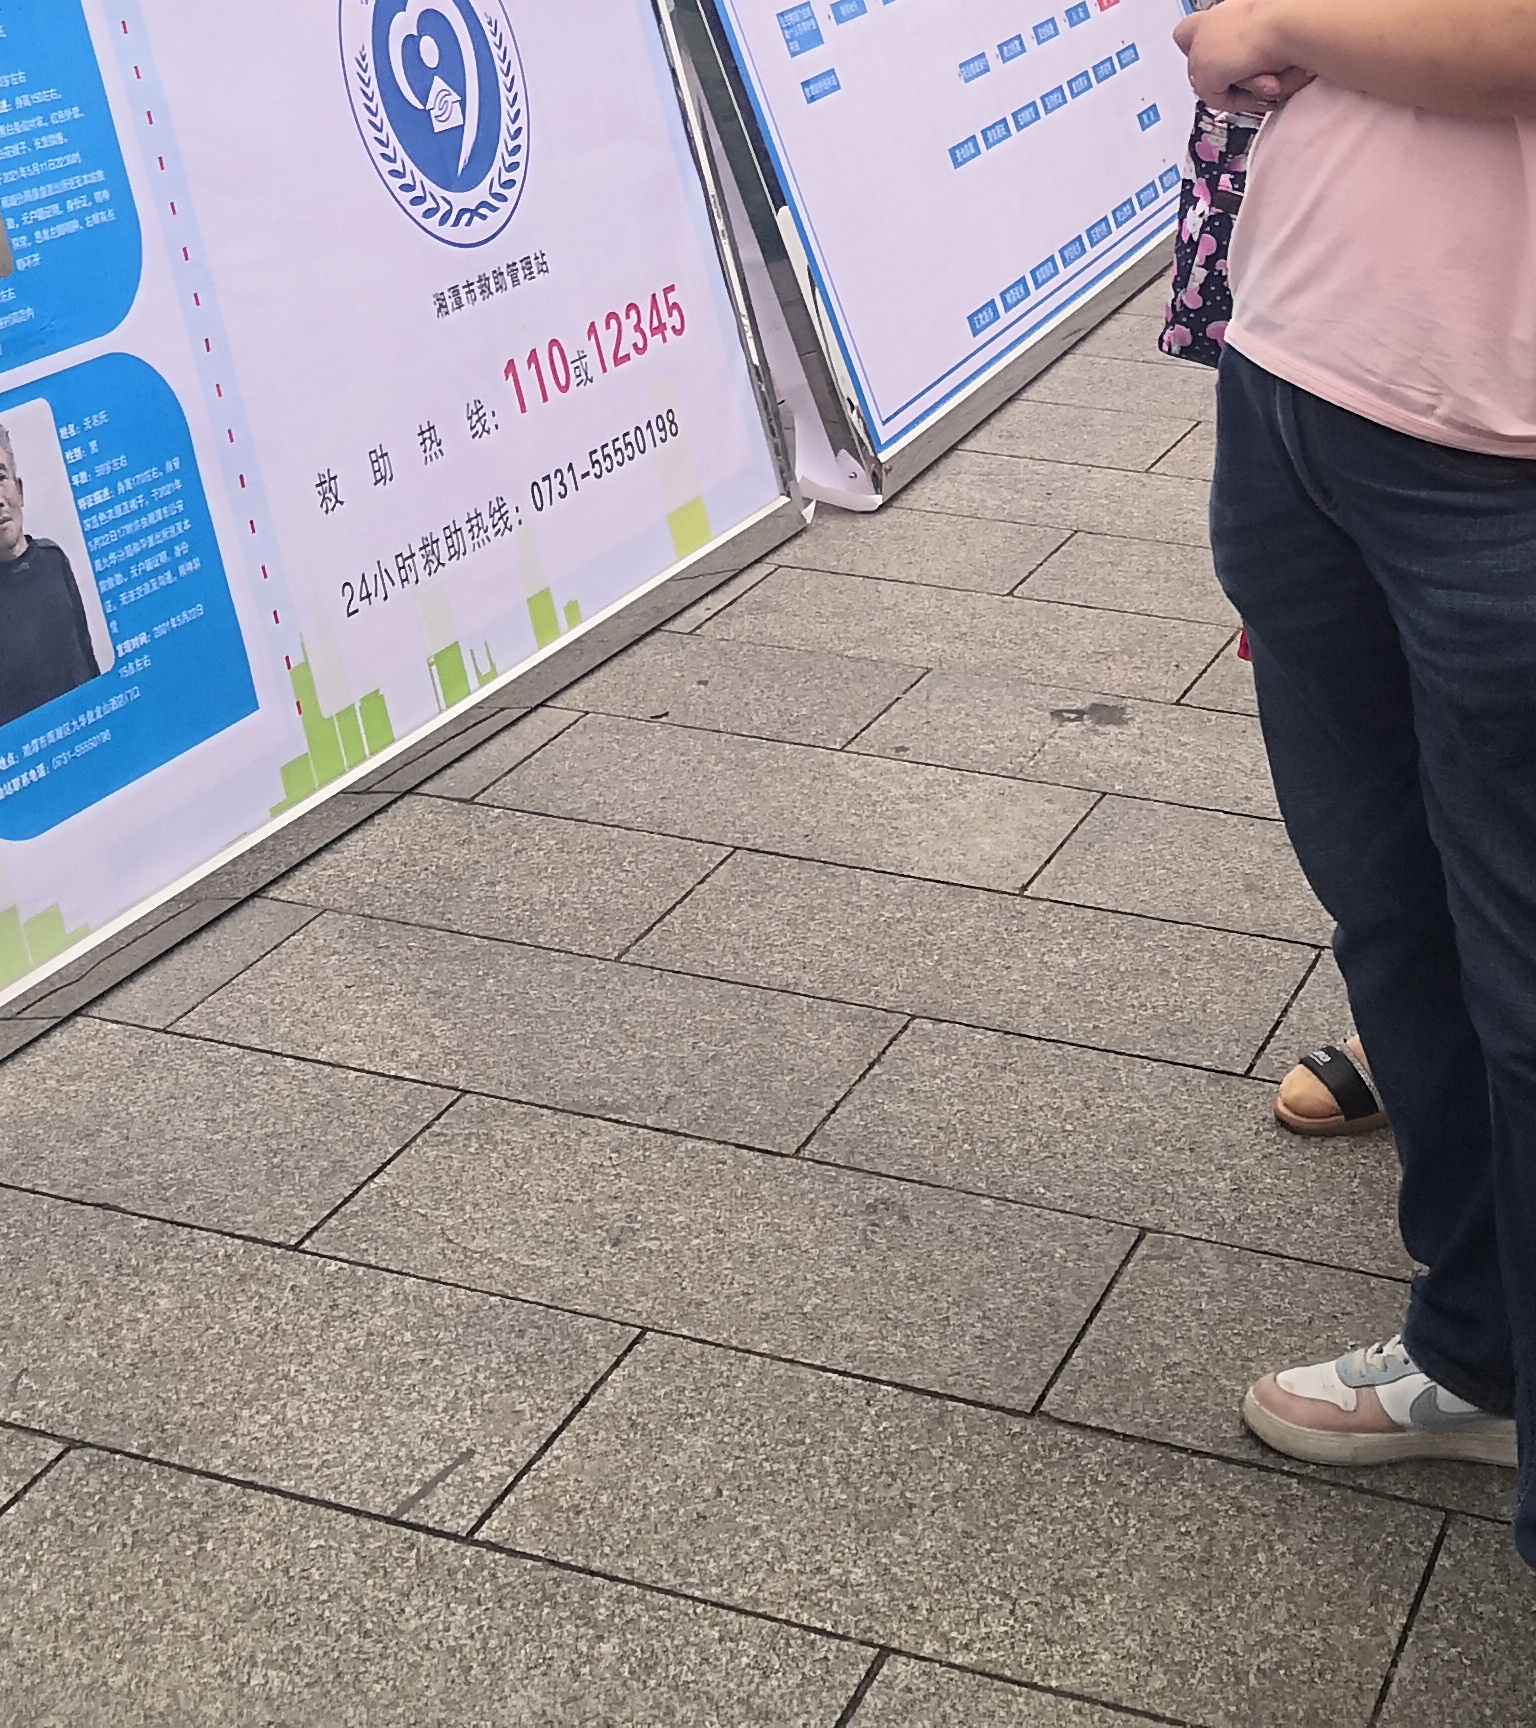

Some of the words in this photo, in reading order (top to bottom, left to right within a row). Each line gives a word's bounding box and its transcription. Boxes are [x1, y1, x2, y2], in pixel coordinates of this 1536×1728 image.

[432, 250, 550, 320] 湘潭市救助管理站
[341, 408, 680, 618] 24小时救助热线：0731-55550198
